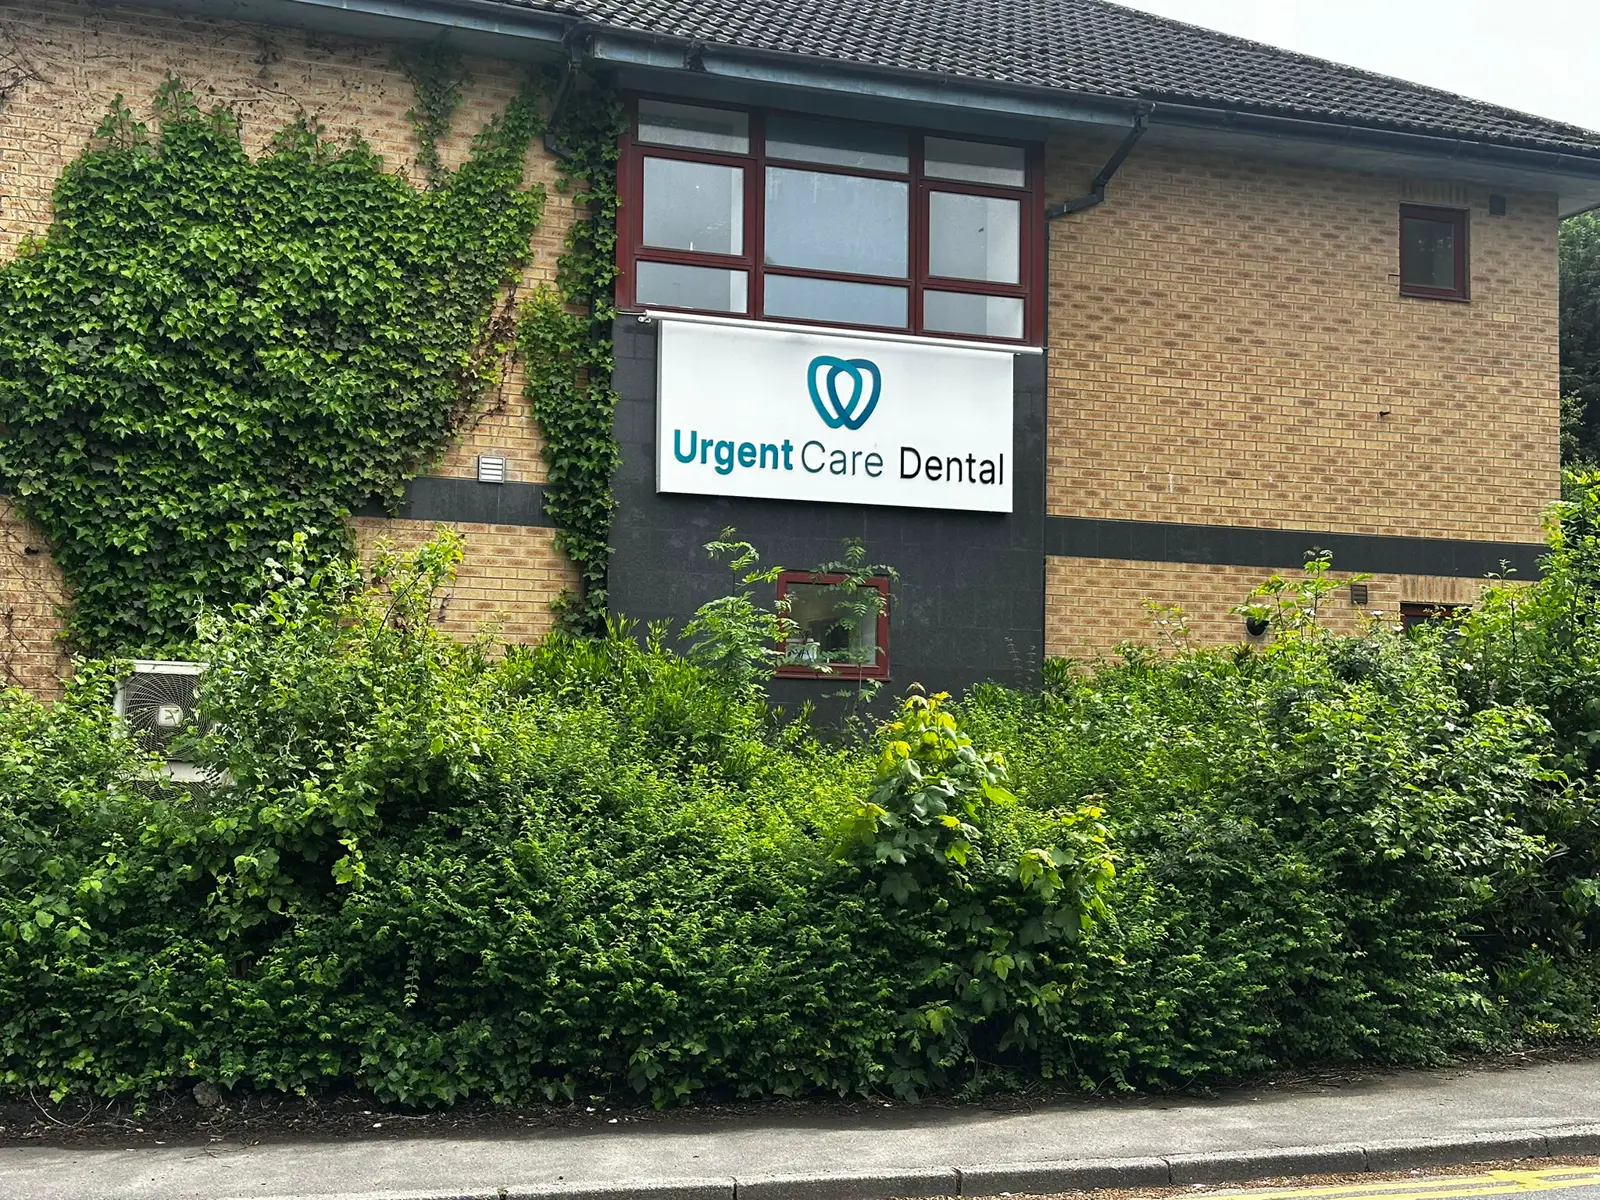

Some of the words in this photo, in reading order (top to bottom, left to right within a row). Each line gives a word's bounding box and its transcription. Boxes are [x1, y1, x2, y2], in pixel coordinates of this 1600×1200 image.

[673, 429, 794, 475] Urgent
[801, 440, 884, 477] Care
[899, 446, 1004, 485] Dental
